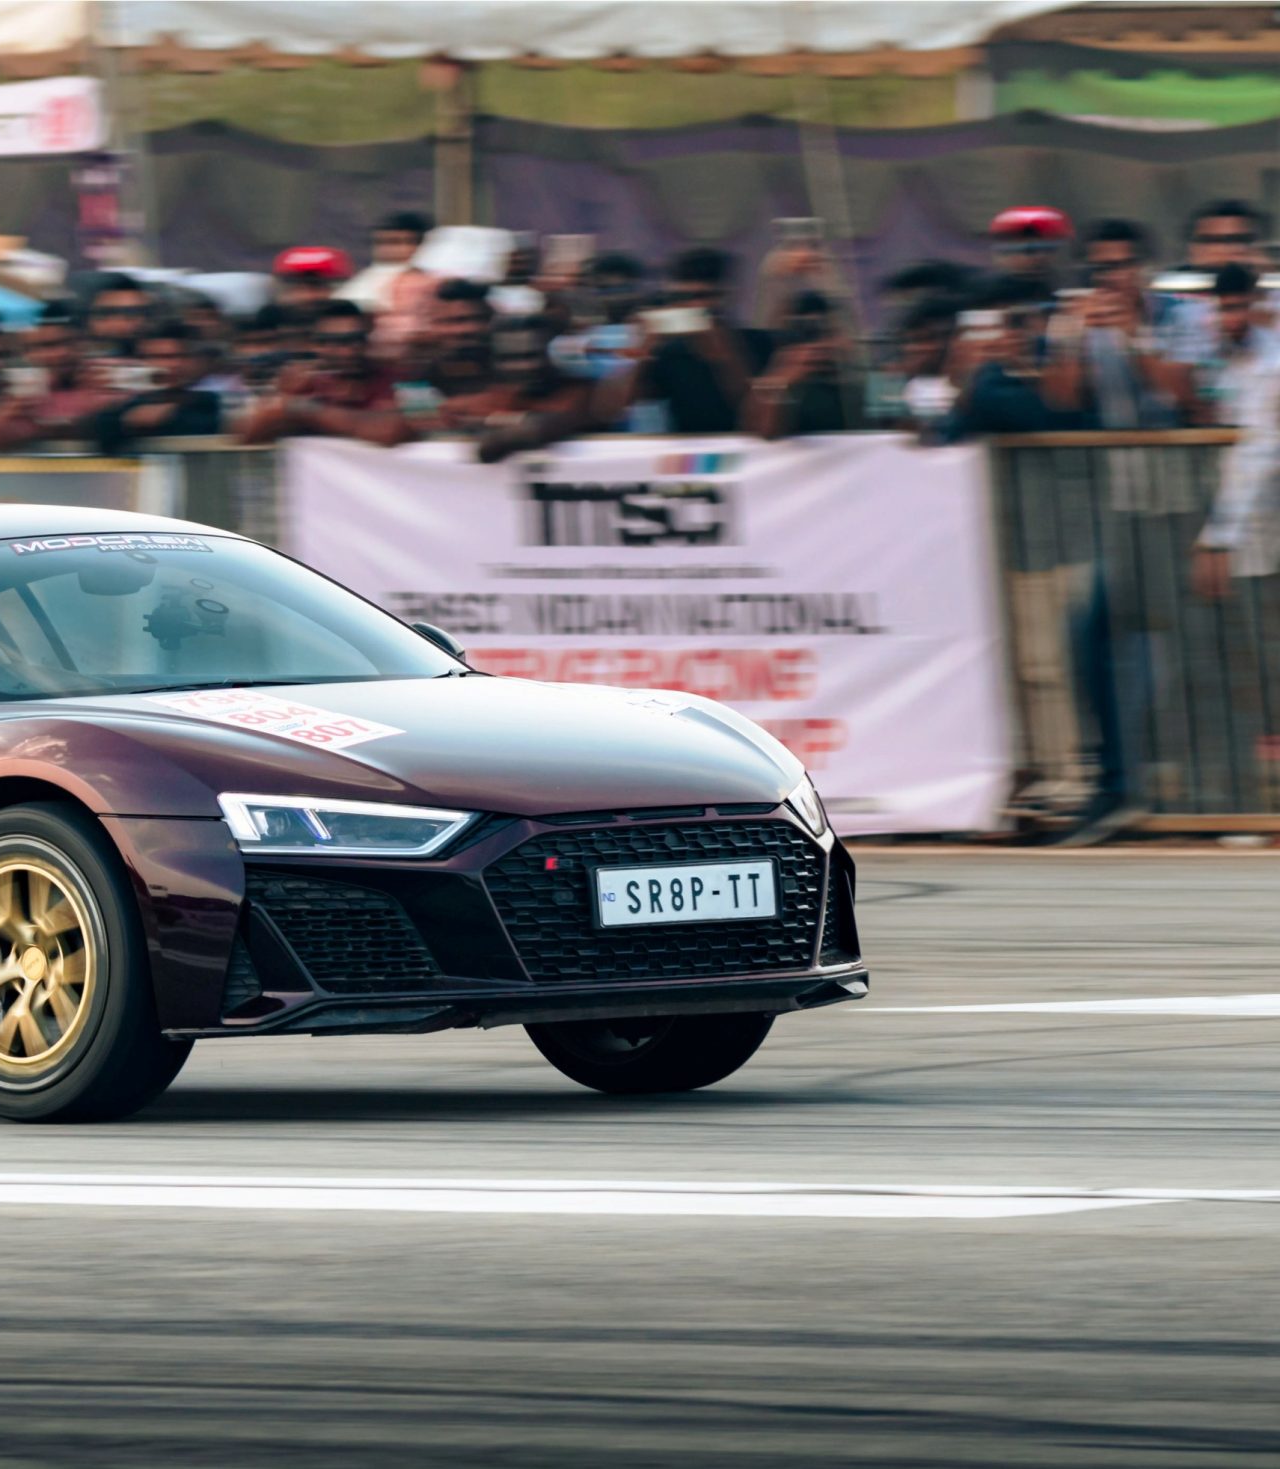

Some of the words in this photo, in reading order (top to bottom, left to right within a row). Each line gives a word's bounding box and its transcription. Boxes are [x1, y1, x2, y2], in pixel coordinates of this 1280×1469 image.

[13, 535, 204, 553] MODCREW
[99, 543, 208, 552] PERFORMANCE
[228, 705, 318, 724] 804
[291, 719, 370, 743] 807
[626, 873, 760, 914] SR8P-TT
